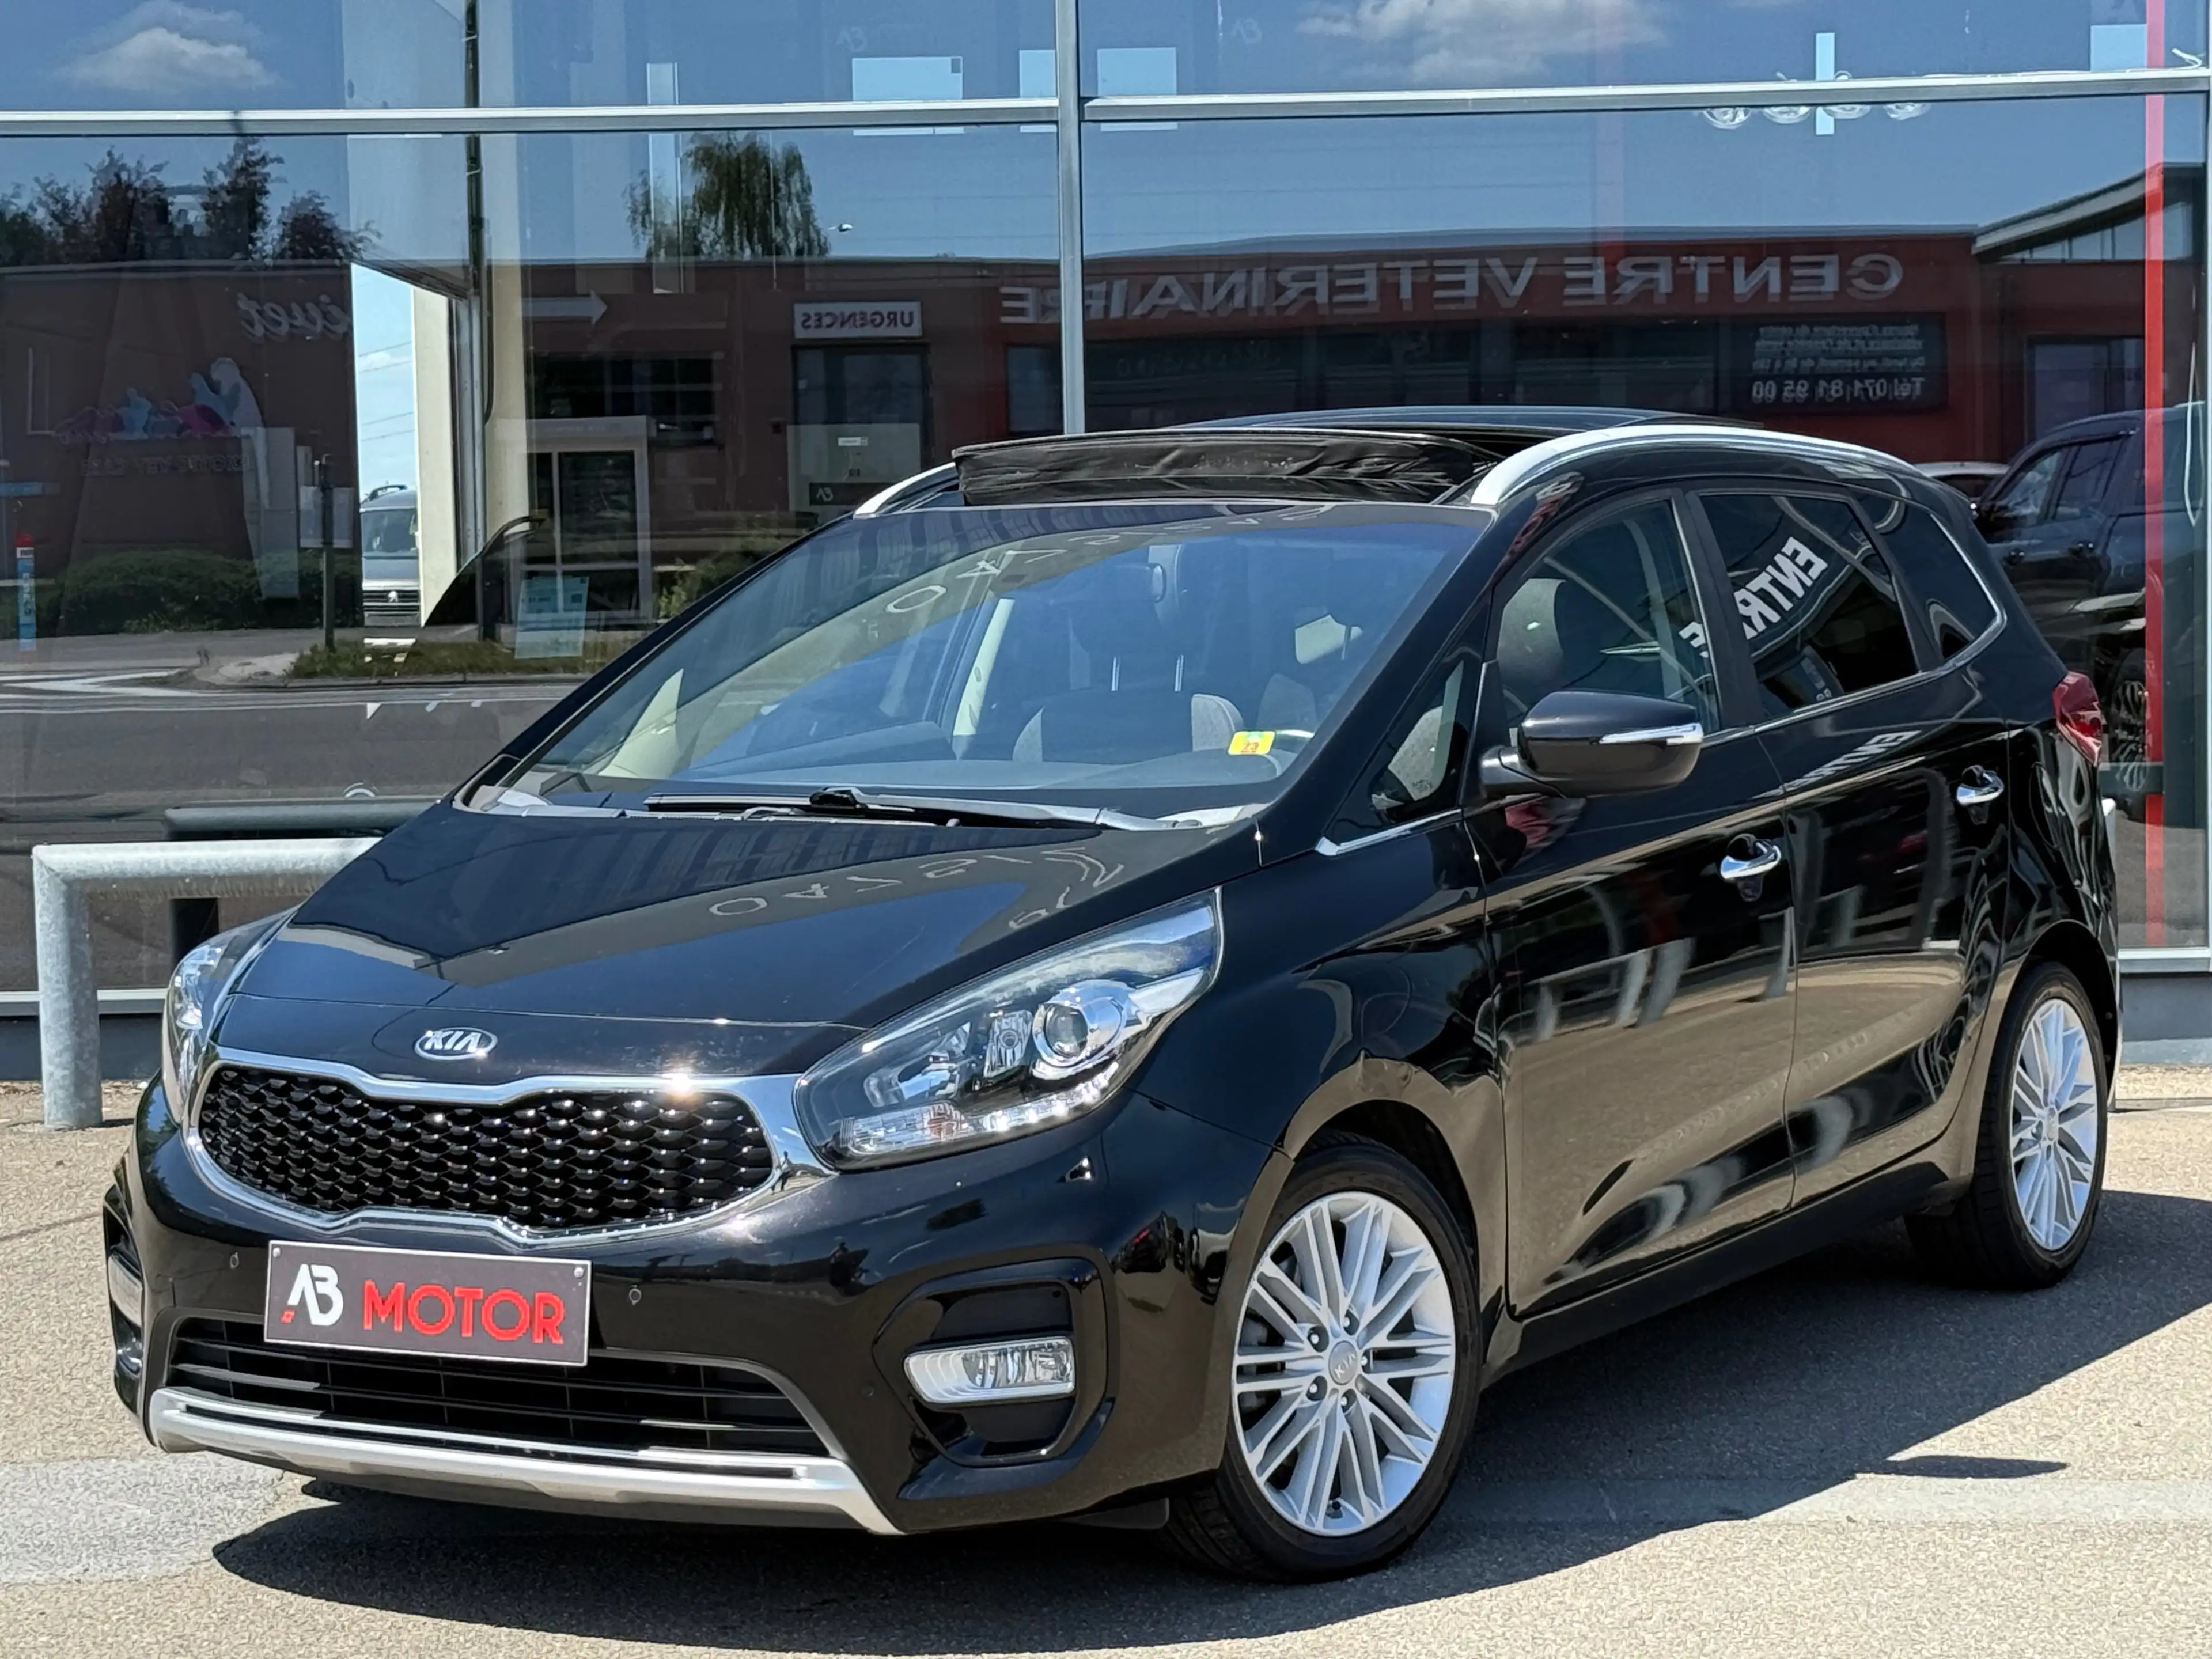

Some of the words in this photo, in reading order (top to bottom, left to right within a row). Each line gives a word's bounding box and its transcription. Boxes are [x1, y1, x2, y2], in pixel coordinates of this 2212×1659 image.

[423, 1029, 482, 1053] KIA
[287, 1263, 344, 1327] AB
[363, 1278, 566, 1345] MOTOR
